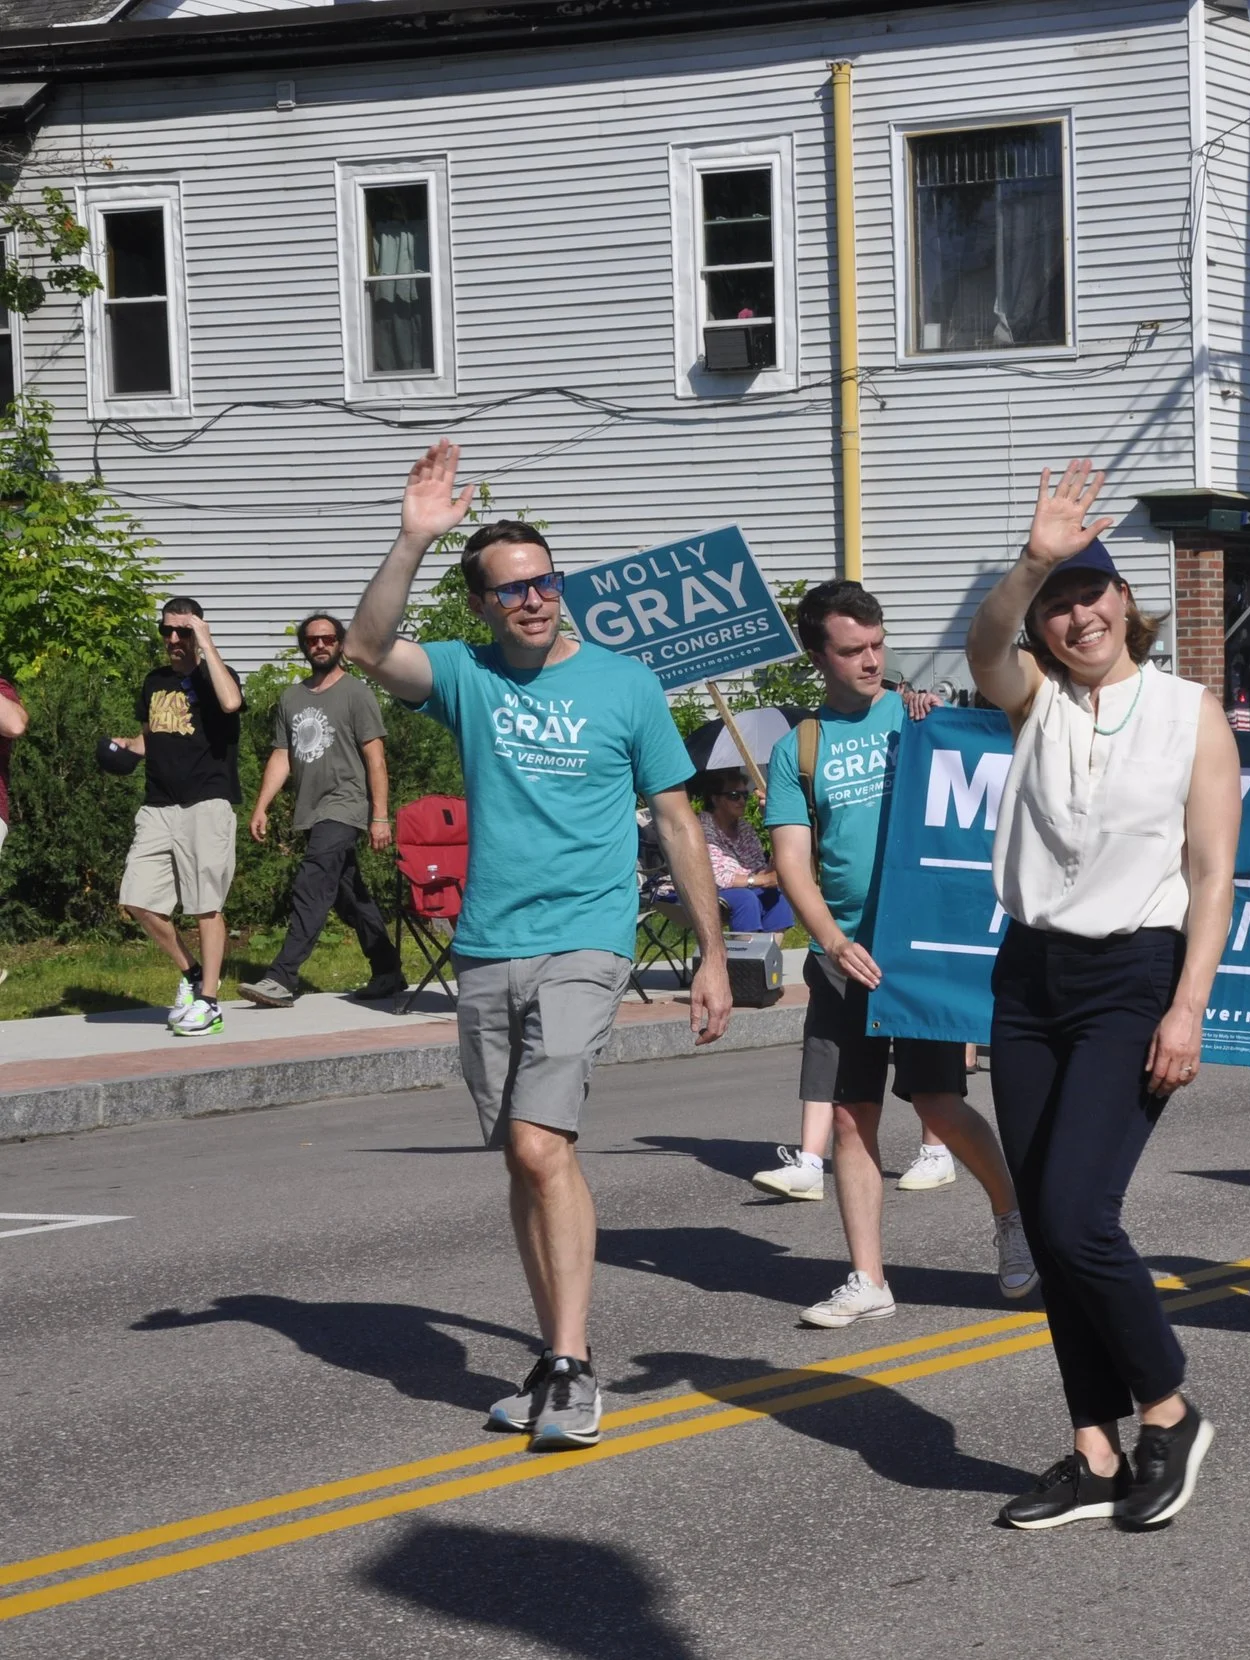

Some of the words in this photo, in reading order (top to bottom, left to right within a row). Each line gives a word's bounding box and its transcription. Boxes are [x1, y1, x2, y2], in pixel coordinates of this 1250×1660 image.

[590, 542, 708, 596] MOLLY
[585, 561, 748, 646] GRAY
[661, 617, 770, 660] CONGRESS
[504, 693, 574, 714] MOLLY
[492, 707, 588, 744] GRAY
[831, 731, 890, 756] MOLLY
[517, 752, 587, 769] VERMONT
[823, 744, 899, 782] GRAY
[828, 789, 851, 803] FOR
[855, 779, 893, 796] VERMO
